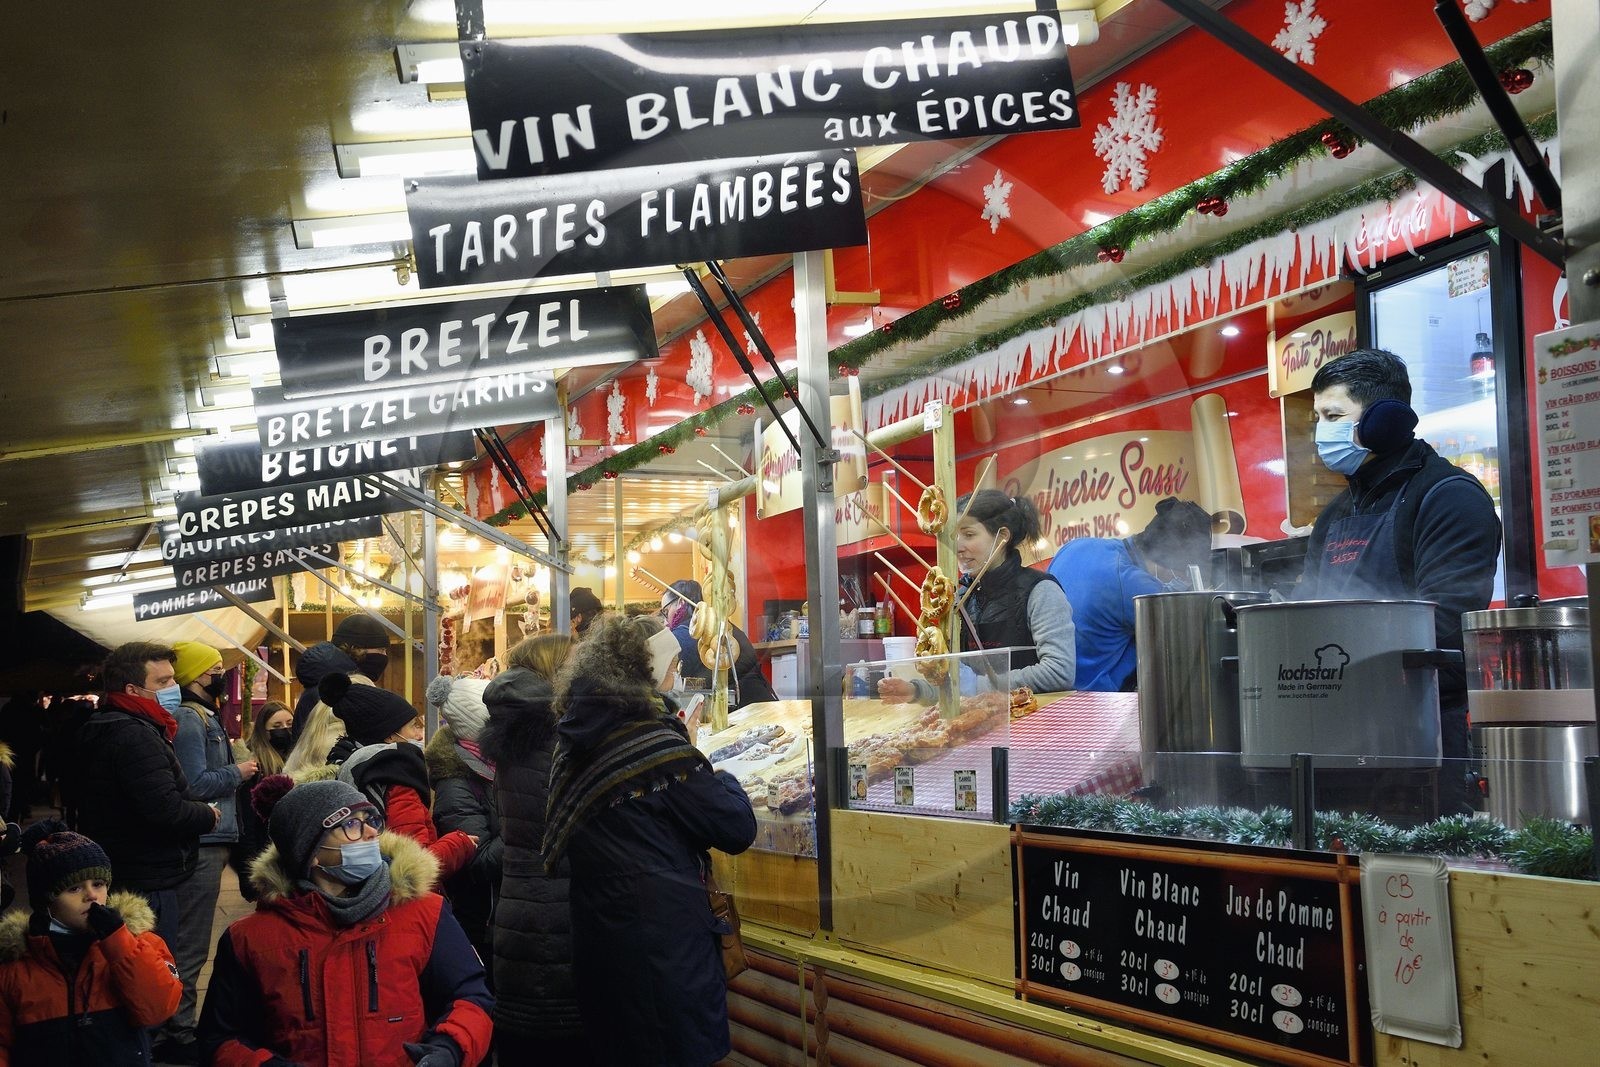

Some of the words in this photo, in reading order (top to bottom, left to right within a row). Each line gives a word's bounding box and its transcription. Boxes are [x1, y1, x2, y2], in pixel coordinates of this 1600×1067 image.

[472, 104, 596, 170] VIN
[627, 59, 842, 140] BLANC
[863, 15, 1060, 89] CHAUD
[824, 112, 898, 141] aux
[917, 89, 1074, 133] ÉPICES
[429, 199, 605, 274] TARTES
[640, 157, 852, 237] FLAMBÉES
[363, 299, 590, 382] BRETZEL
[1551, 360, 1597, 378] BOISSONS
[268, 397, 417, 448] BRETZEL
[429, 371, 548, 415] GARNIS
[262, 435, 418, 483] BEIGNET
[1118, 440, 1191, 509] Sassi
[179, 493, 295, 537] CRÊPES
[307, 468, 422, 511] MAISN
[1055, 517, 1090, 547] depuis
[139, 593, 196, 618] POMME
[1278, 663, 1339, 681] kochstar
[1278, 683, 1296, 691] Made
[1298, 683, 1304, 691] in
[1306, 682, 1342, 692] Germany
[1054, 861, 1079, 889] Vin
[1120, 868, 1145, 899] Vin
[1152, 872, 1200, 907] Blanc
[1385, 873, 1414, 899] CB
[1042, 895, 1090, 929] Chaud
[1226, 885, 1250, 917] Jus
[1256, 888, 1273, 921] de
[1278, 890, 1334, 931] Pomme
[1378, 906, 1387, 924] à
[1396, 907, 1431, 933] partir
[1031, 932, 1054, 951] 20cl
[1135, 909, 1187, 946] Chaud
[1400, 930, 1413, 951] de
[1031, 955, 1054, 974] 30cl
[1120, 950, 1147, 972] 20cl
[1256, 931, 1305, 971] Chaud
[1229, 972, 1262, 996] 20cl
[1394, 954, 1423, 985] 10€
[1121, 974, 1148, 996] 30cl
[1230, 999, 1263, 1024] 30cl
[1307, 1017, 1340, 1038] consigne
